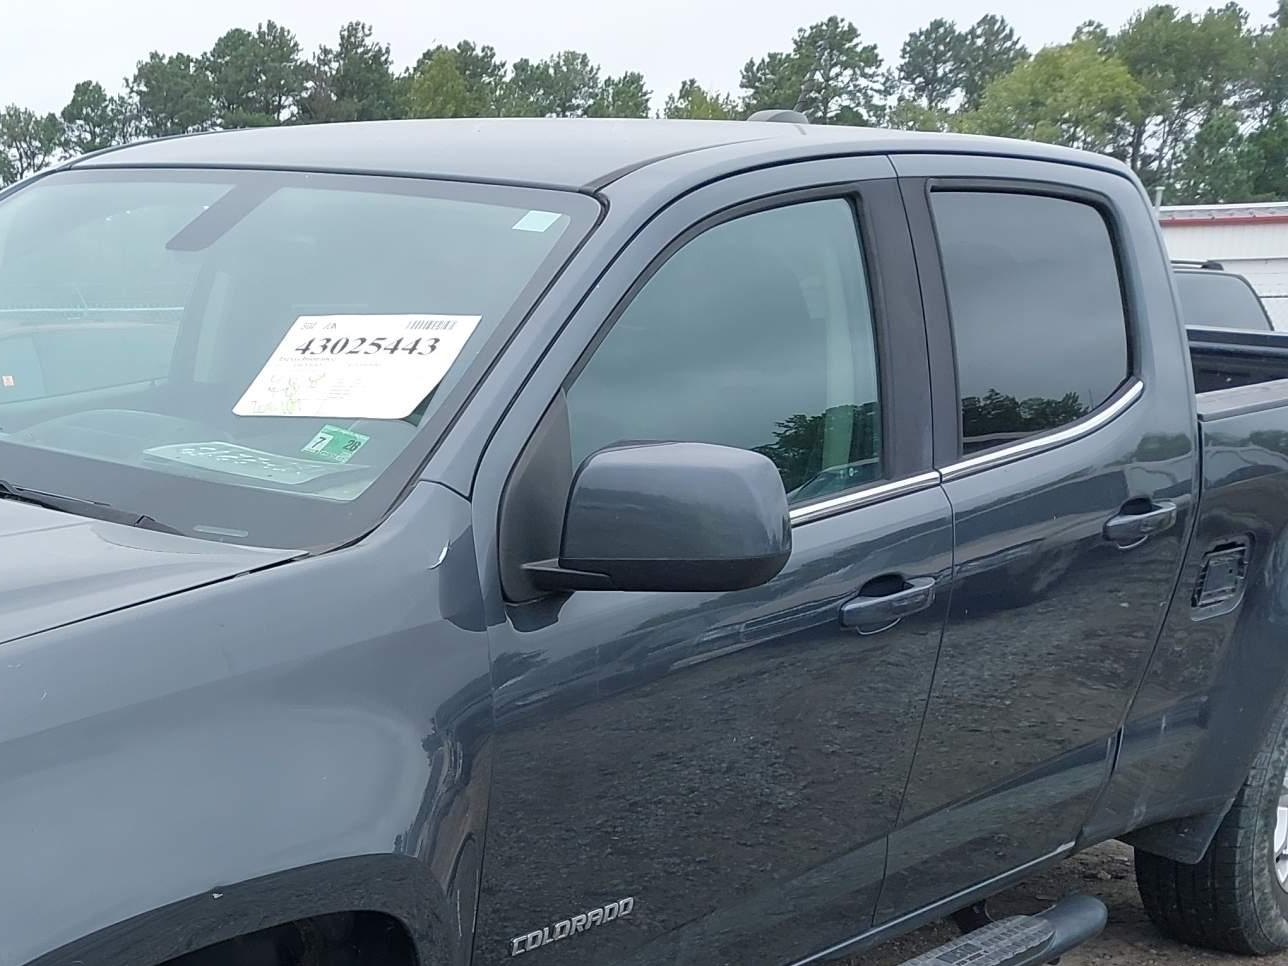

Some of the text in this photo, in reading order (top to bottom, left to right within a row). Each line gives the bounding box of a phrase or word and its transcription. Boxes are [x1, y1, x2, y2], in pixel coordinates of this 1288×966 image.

[295, 337, 441, 356] 43025443
[312, 437, 327, 449] 7
[512, 897, 634, 956] COLORADO
